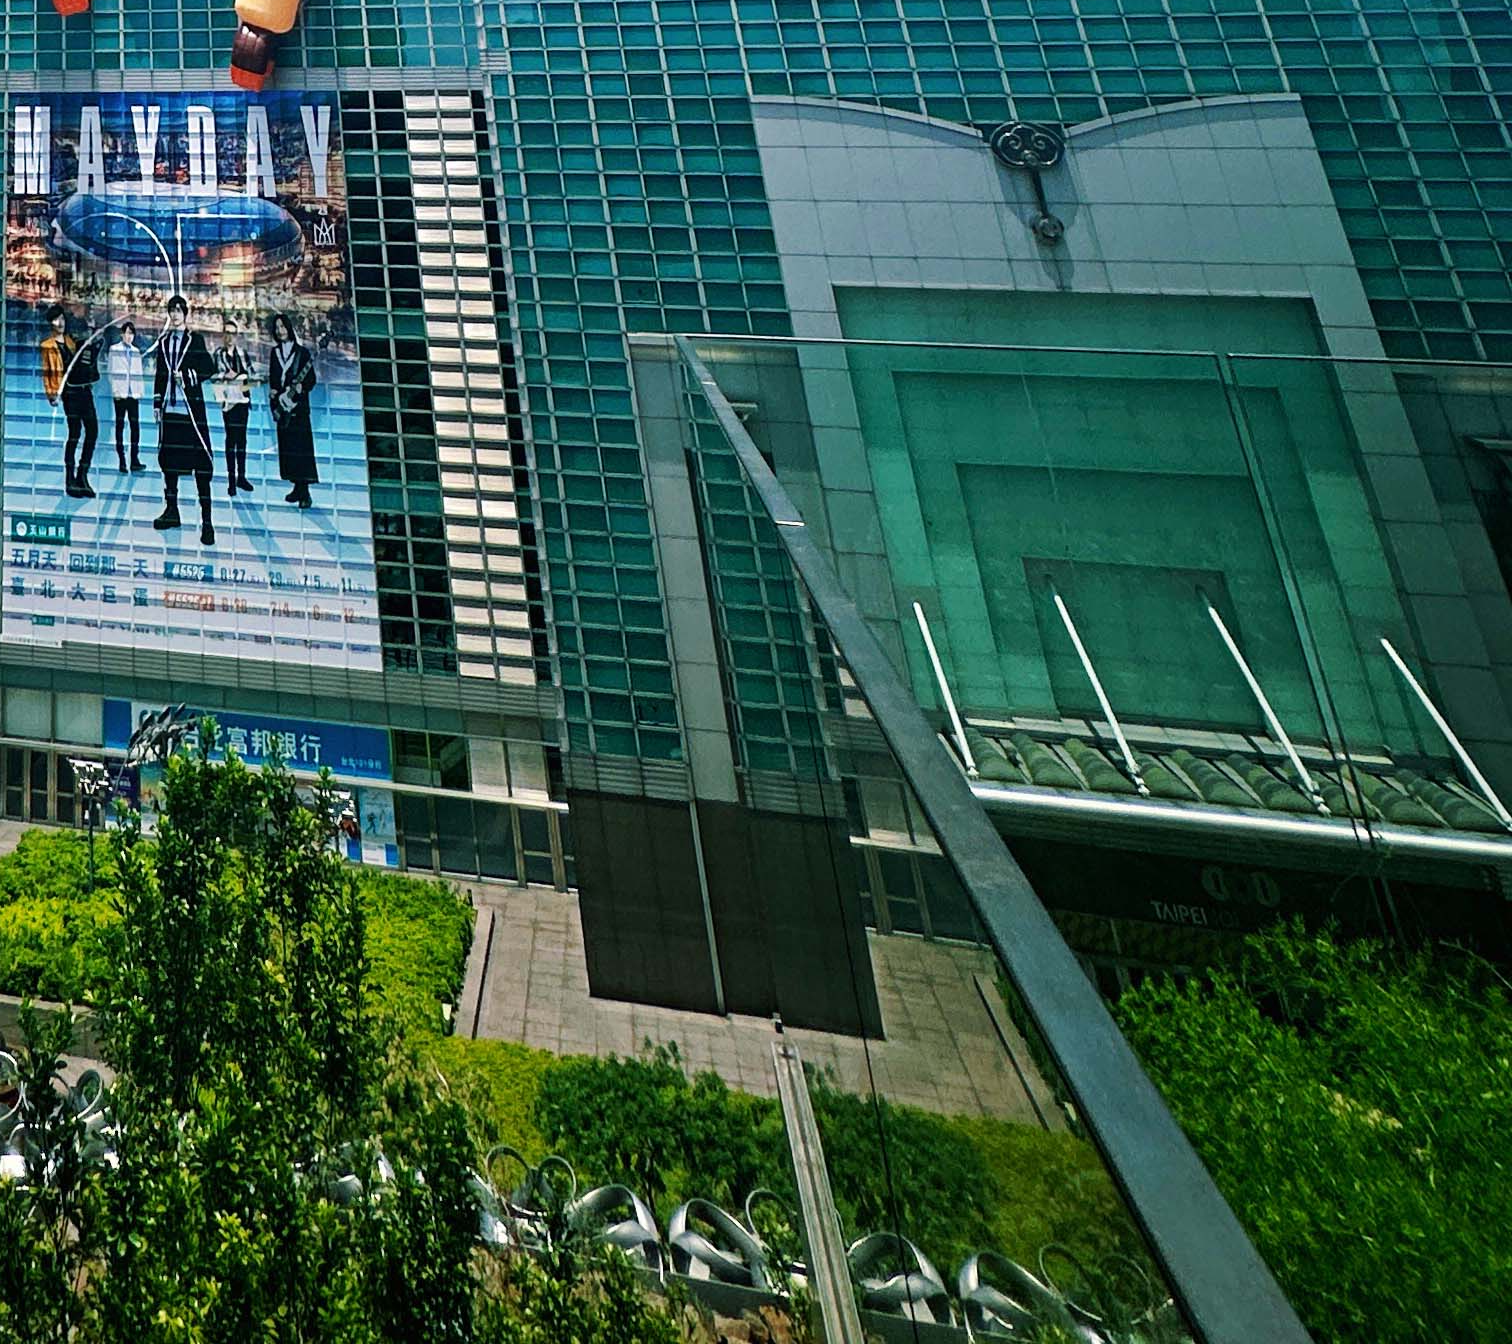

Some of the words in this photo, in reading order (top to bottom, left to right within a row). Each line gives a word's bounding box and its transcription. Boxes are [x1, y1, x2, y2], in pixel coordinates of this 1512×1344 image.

[14, 106, 331, 198] MAYDAY
[11, 548, 57, 571] 五月天
[69, 553, 149, 579] 回到那一天
[10, 577, 149, 607] 臺北大巨蛋
[1150, 899, 1209, 926] TAIPEI
